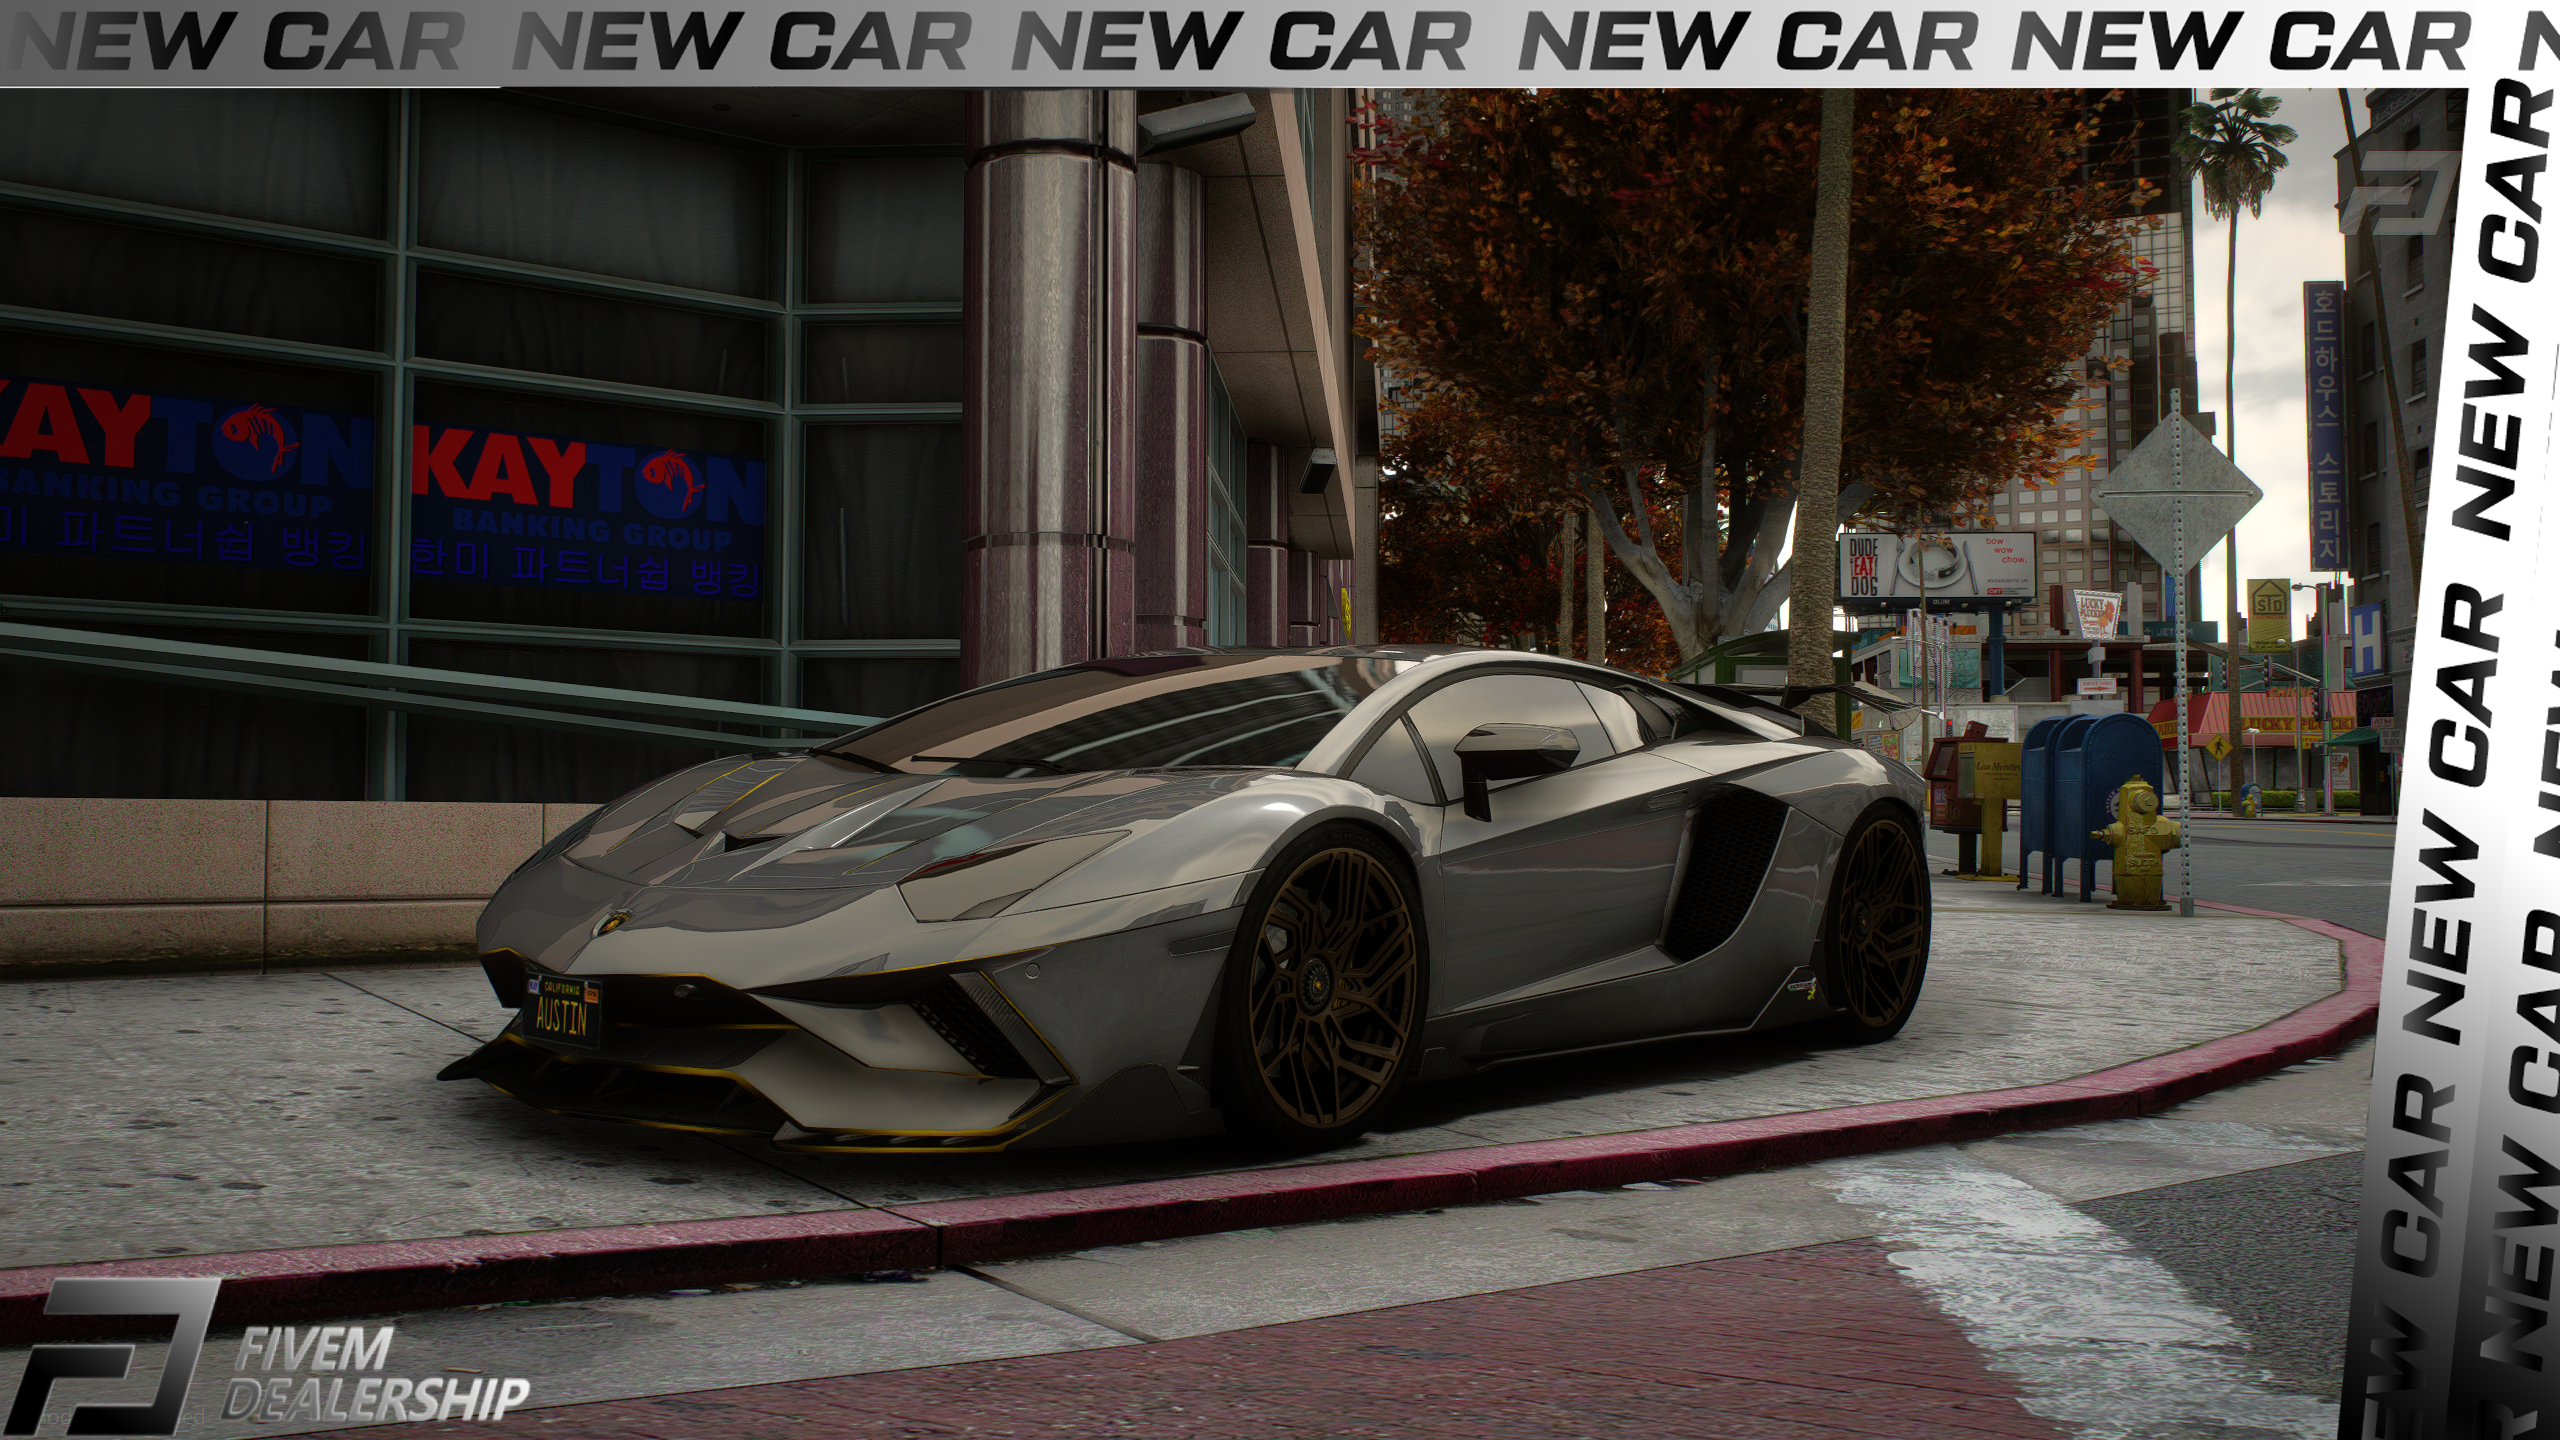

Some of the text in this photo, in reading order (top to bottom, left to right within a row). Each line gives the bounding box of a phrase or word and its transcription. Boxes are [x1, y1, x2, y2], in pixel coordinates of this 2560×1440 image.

[0, 379, 375, 491] AYTON
[412, 424, 766, 526] KAYTON
[197, 485, 333, 519] GROUP
[2317, 452, 2341, 564] 스토리지
[57, 509, 254, 562] 파트너쉽
[283, 527, 366, 570] 뱅킹
[453, 507, 733, 552] BANKING GROUP
[1850, 538, 1879, 556] DUDE
[411, 537, 759, 598] 한미 파트너쉽 뱅킹
[1851, 577, 1878, 596] DOG
[2257, 594, 2283, 612] STD
[2157, 628, 2194, 636] JETM
[2354, 610, 2381, 674] H
[2241, 718, 2292, 730] LUCKY
[1976, 761, 1991, 770] Las
[1331, 832, 1392, 858] MICHELIN
[544, 980, 580, 996] CALIFORNIA
[536, 996, 588, 1036] AUSTIN
